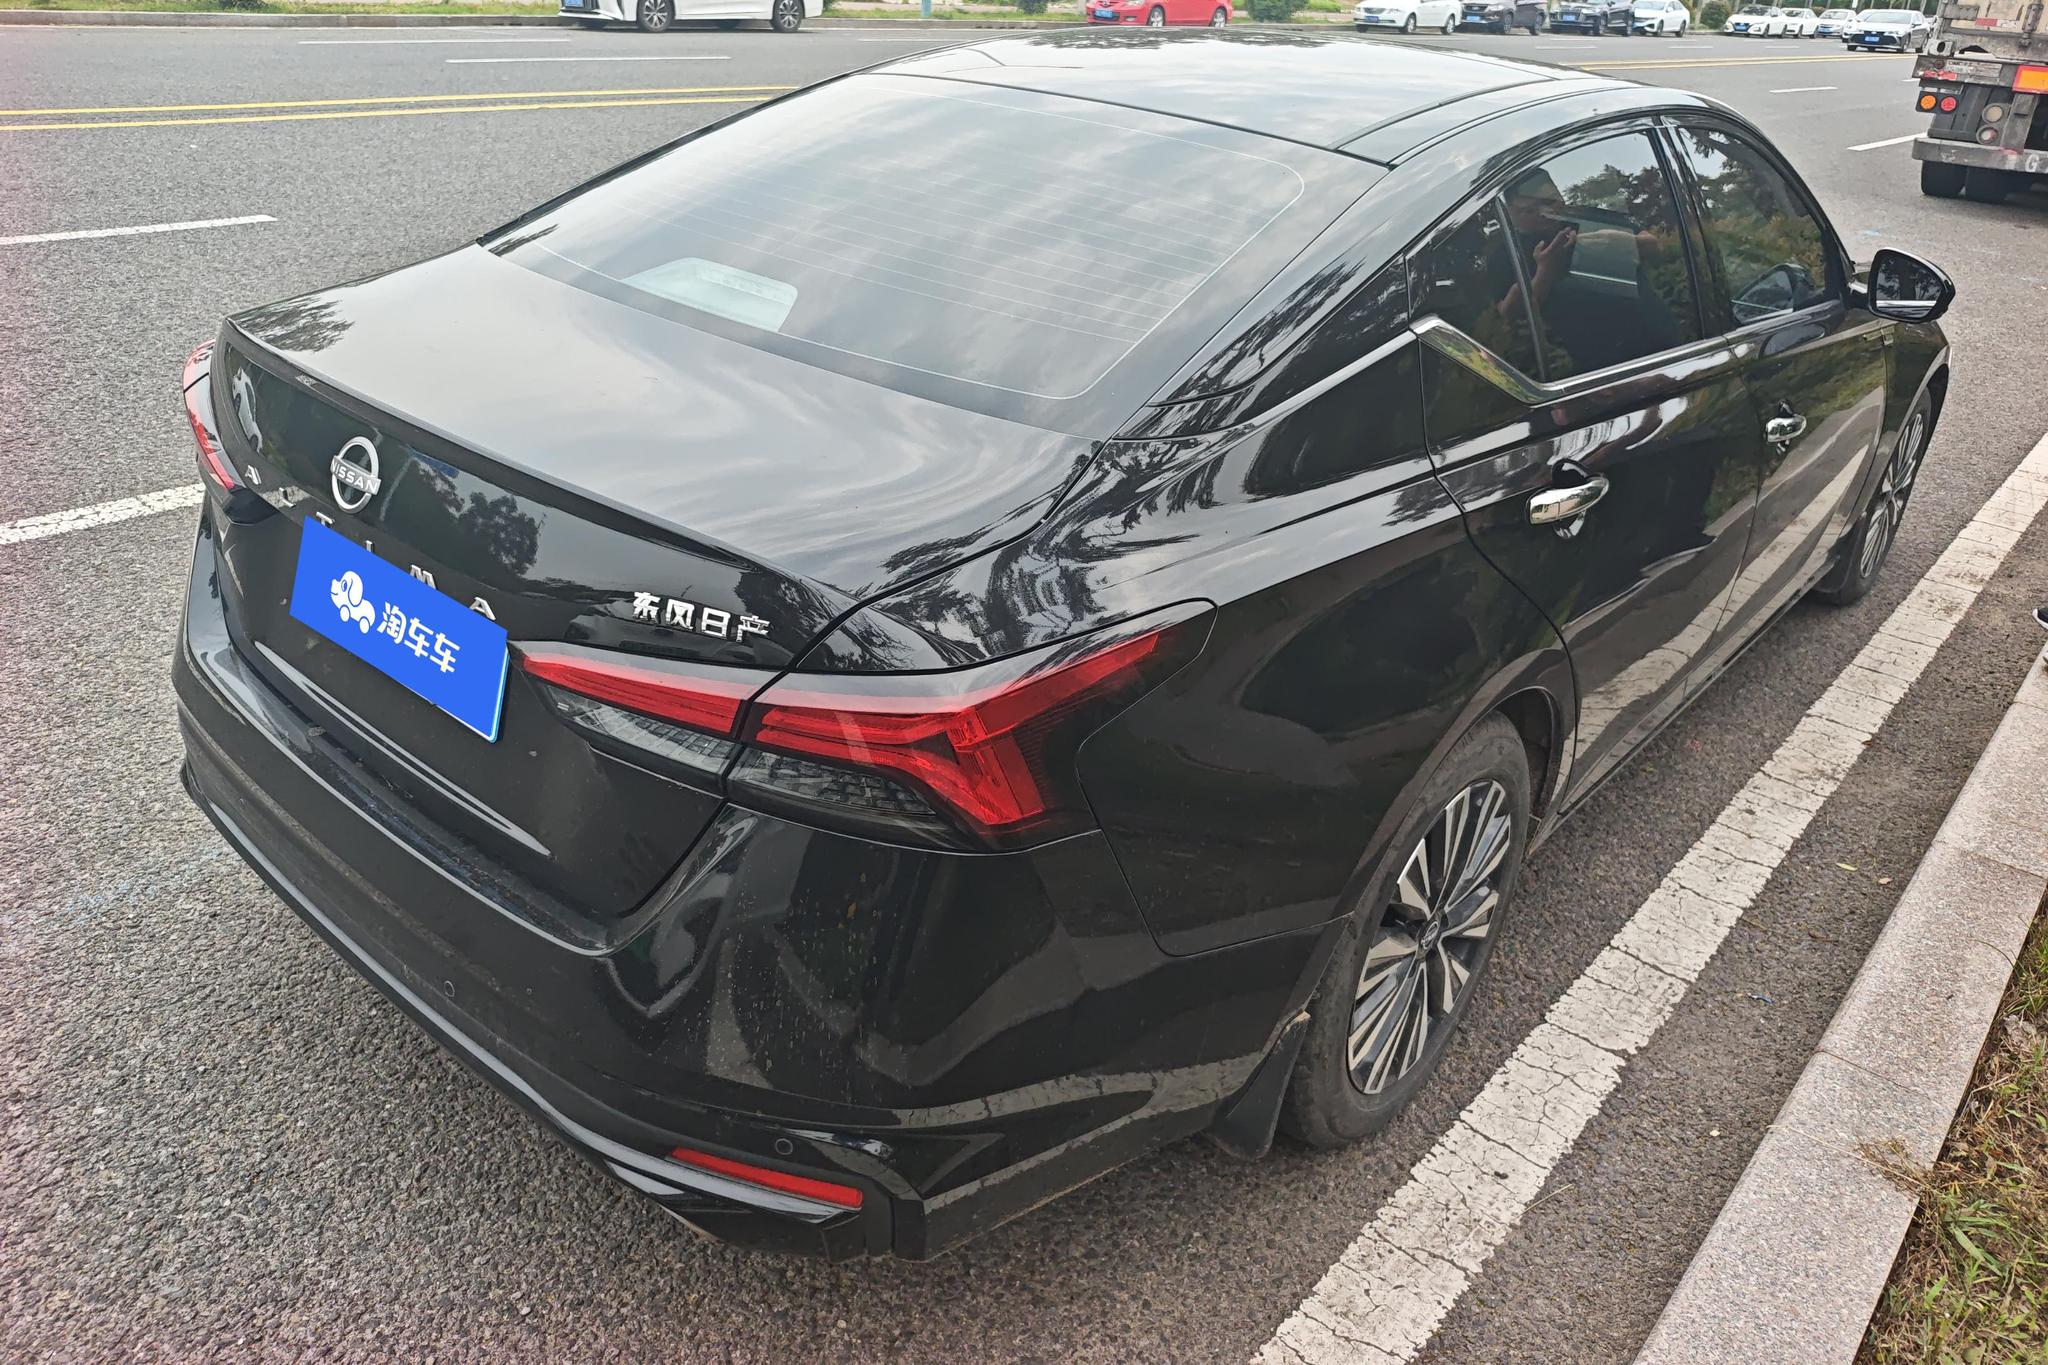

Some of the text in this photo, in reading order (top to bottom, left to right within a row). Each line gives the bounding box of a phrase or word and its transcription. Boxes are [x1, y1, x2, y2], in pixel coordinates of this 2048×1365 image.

[331, 461, 379, 495] NISSAN
[632, 591, 771, 643] 东风日产
